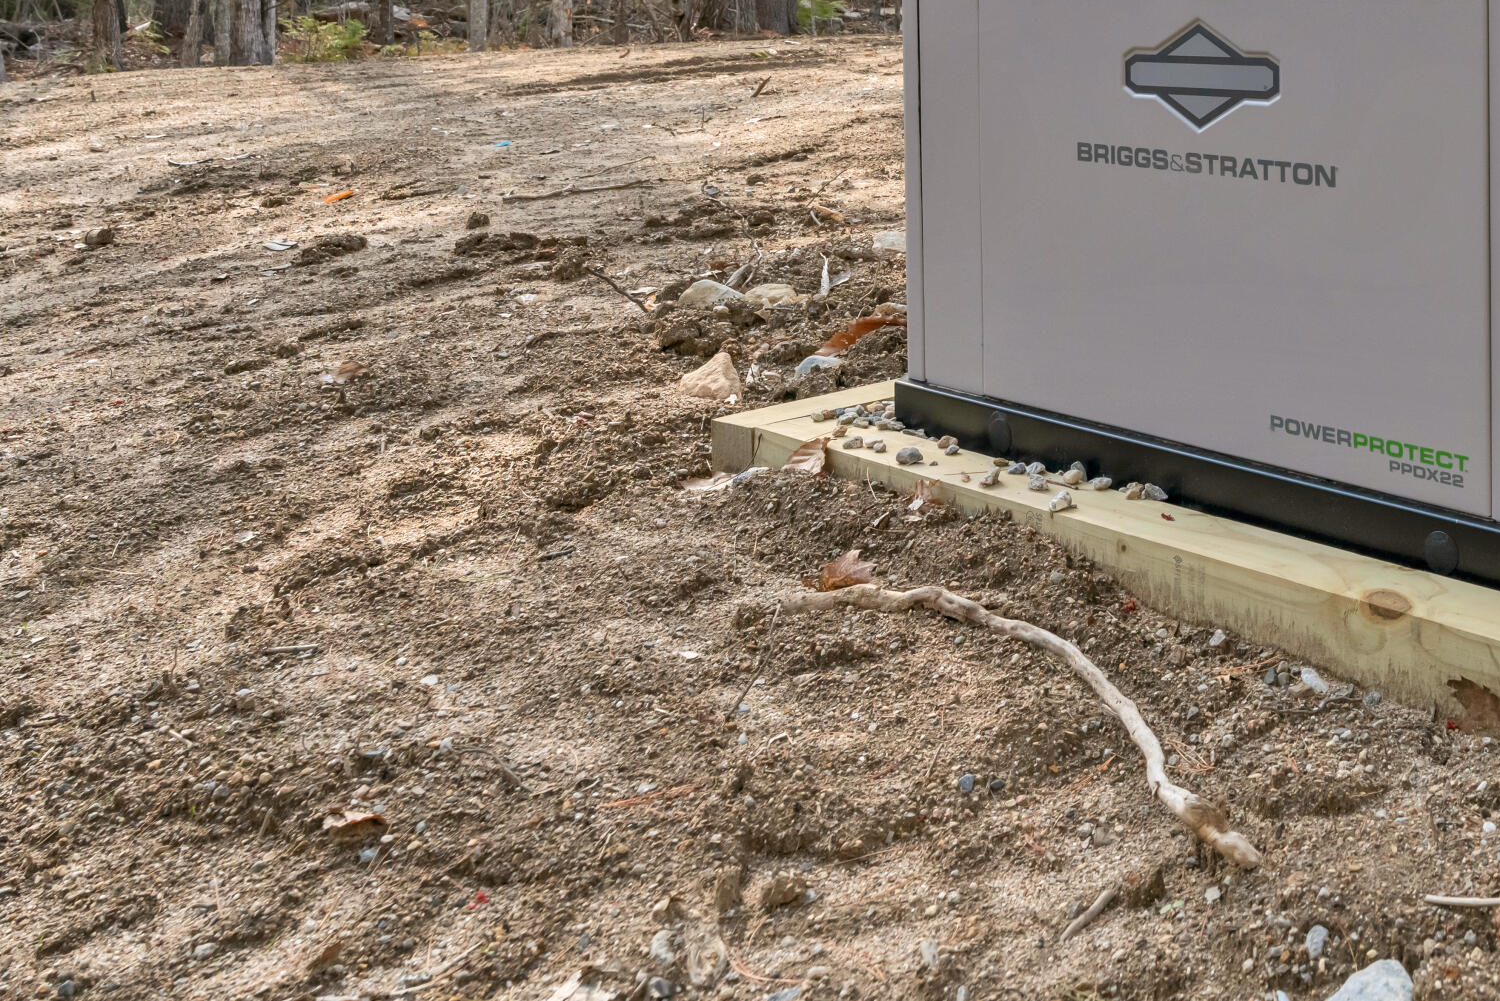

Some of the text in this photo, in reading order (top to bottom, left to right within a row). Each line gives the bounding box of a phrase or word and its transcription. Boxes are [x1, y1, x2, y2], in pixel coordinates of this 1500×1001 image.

[1076, 142, 1337, 188] BRIGGS&STRATTON
[1270, 414, 1469, 473] POWERPROTECT
[1389, 460, 1465, 489] PPDX22
